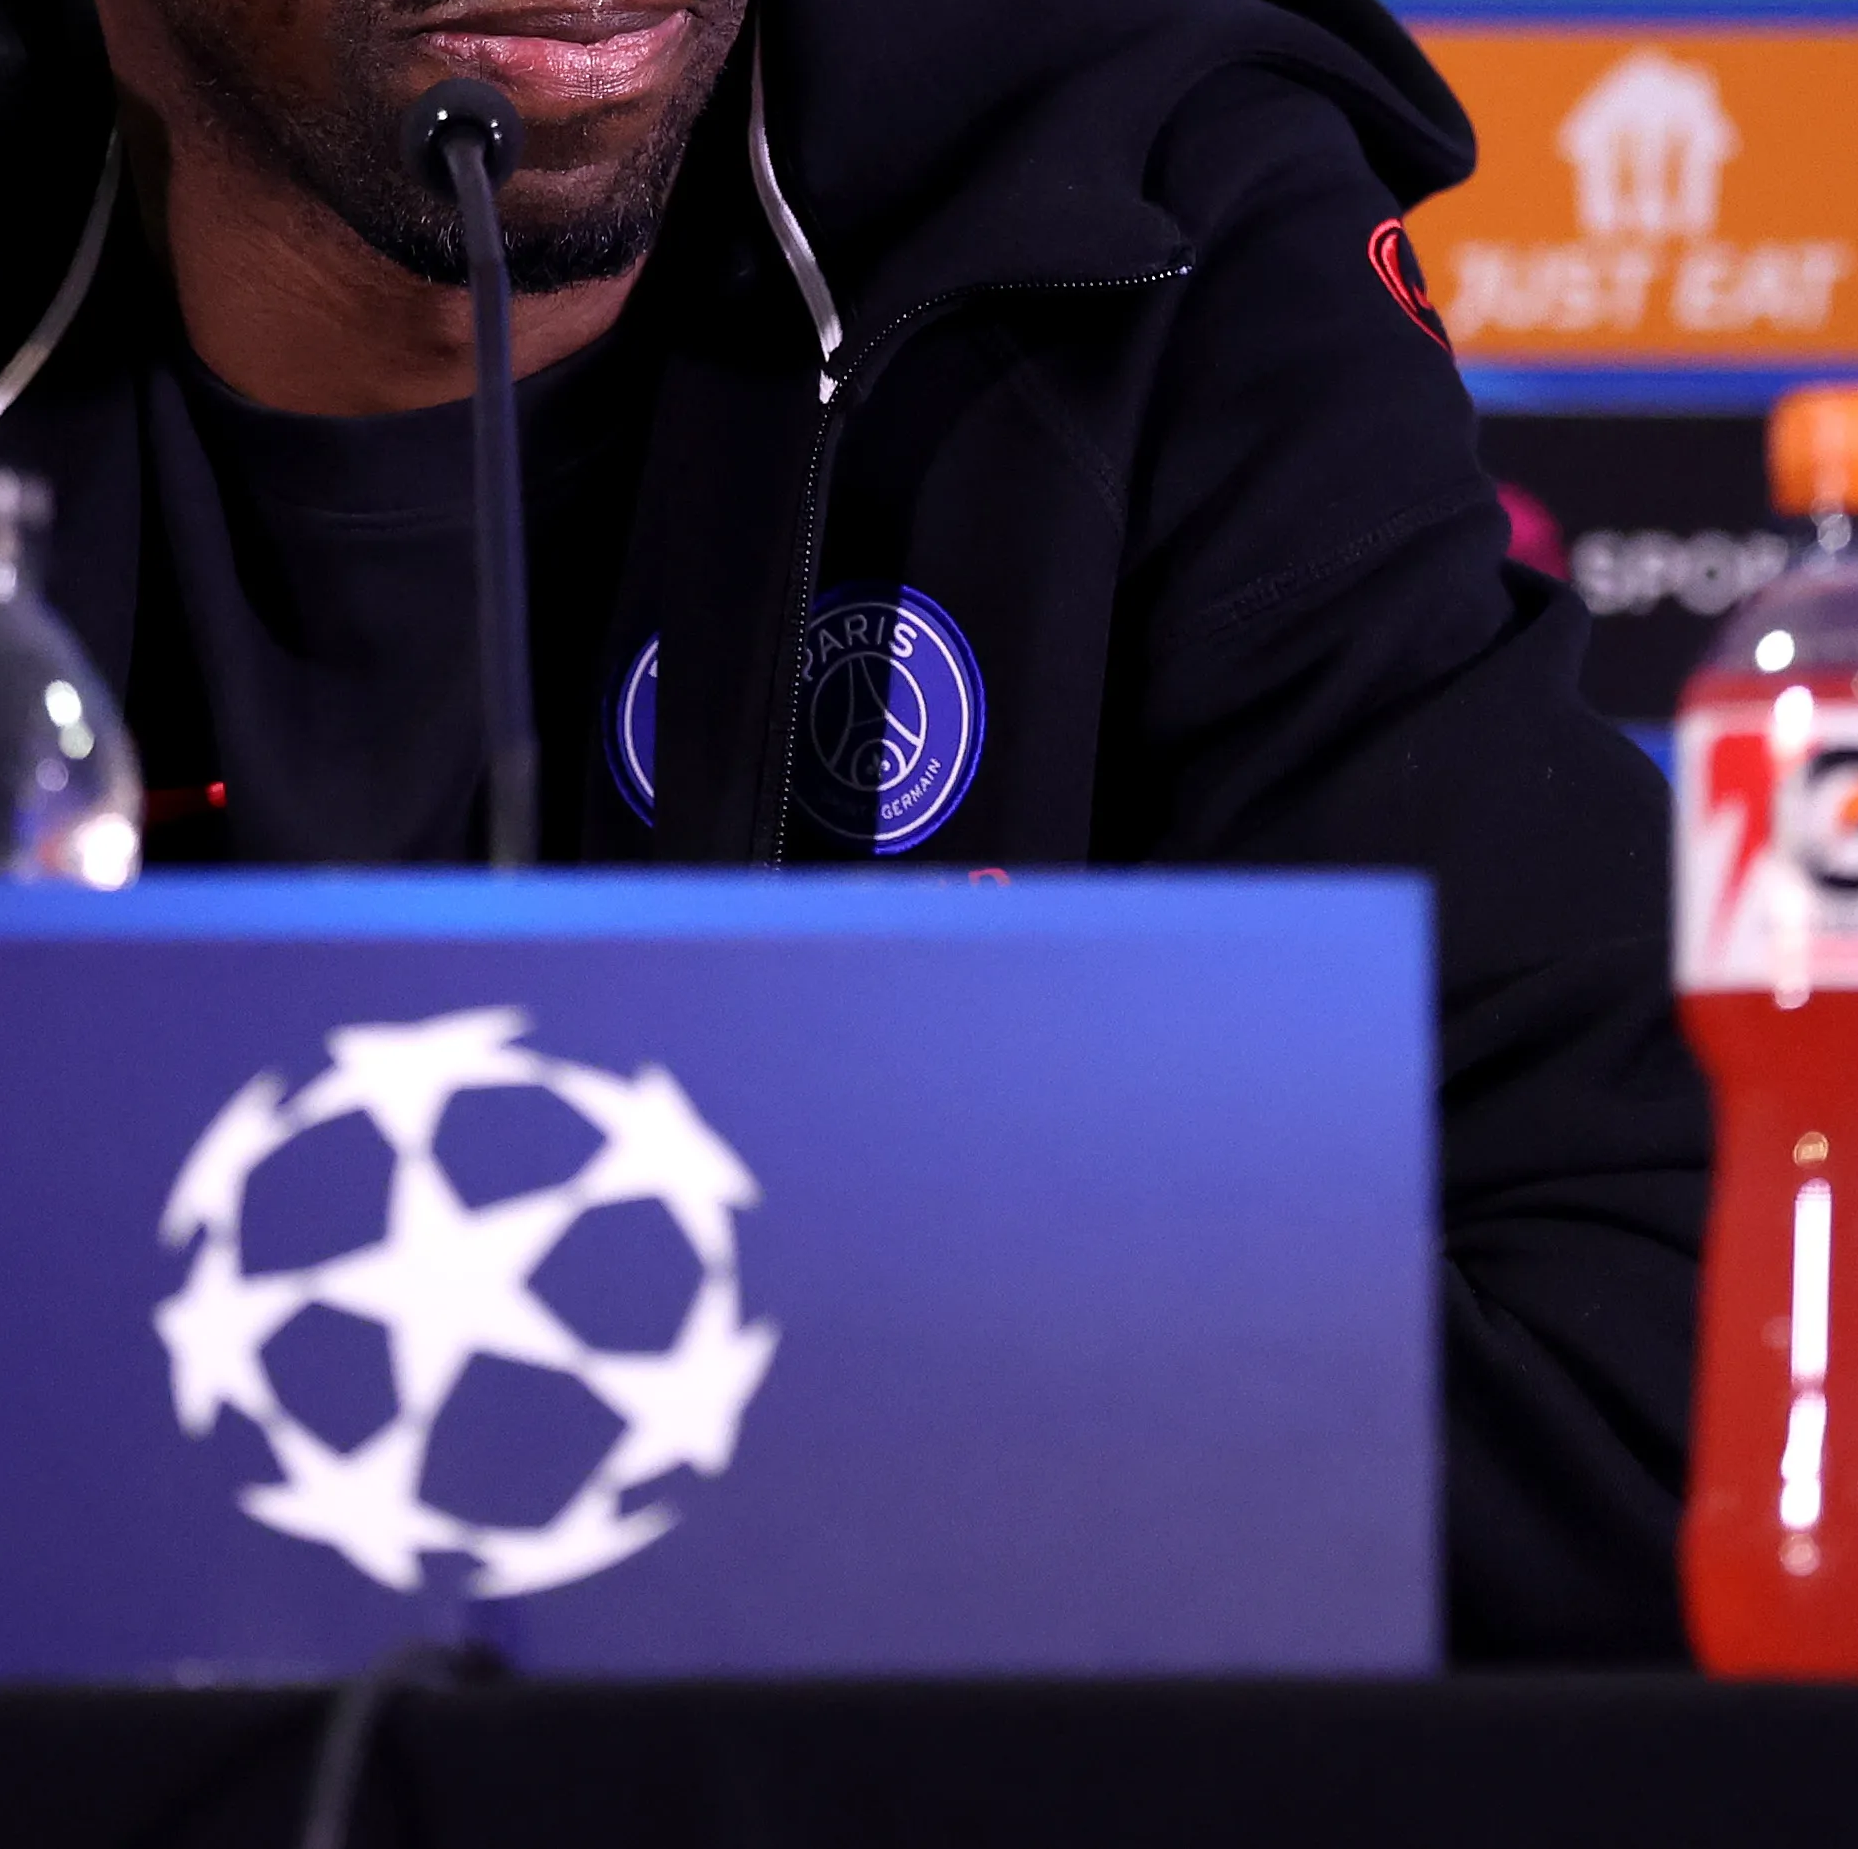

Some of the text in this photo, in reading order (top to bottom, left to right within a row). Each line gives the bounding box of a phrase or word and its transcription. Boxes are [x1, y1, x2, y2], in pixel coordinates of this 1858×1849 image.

[1447, 239, 1850, 340] JUST EAT
[1571, 528, 1789, 616] SPOR
[880, 757, 942, 820] GERMAIN
